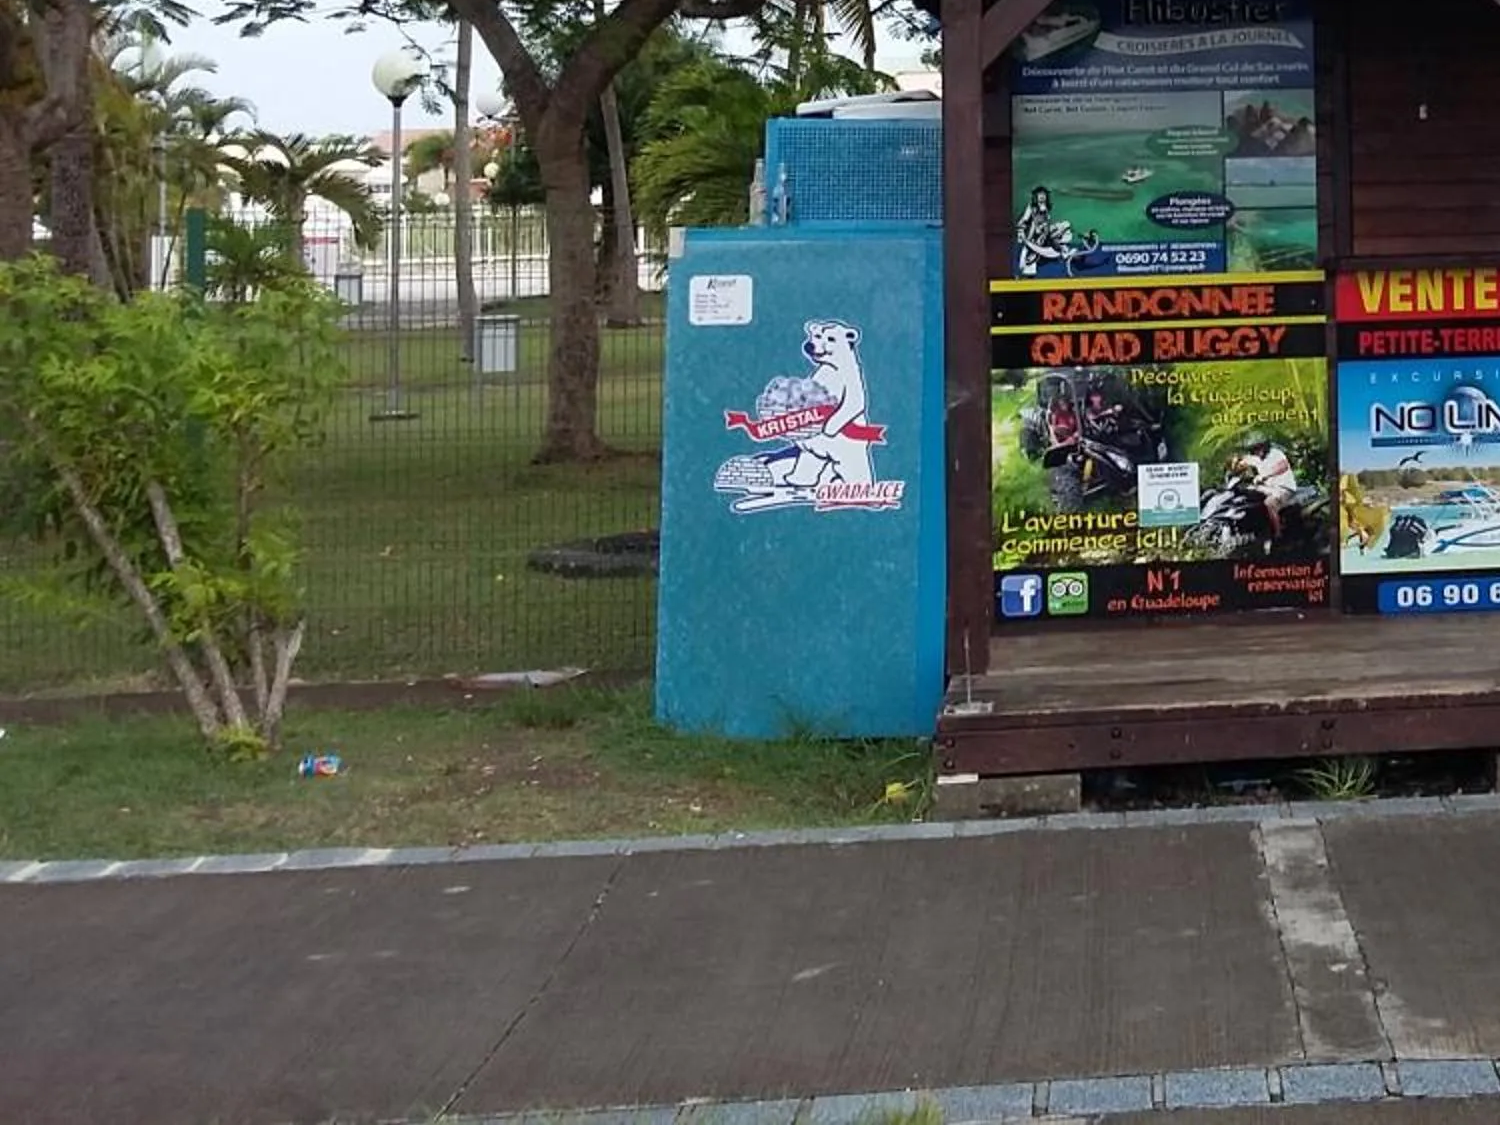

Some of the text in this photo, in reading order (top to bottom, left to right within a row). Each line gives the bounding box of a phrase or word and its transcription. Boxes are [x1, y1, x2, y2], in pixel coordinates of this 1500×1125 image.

[1115, 251, 1149, 264] 0690
[1151, 251, 1168, 263] 74
[1189, 250, 1206, 263] 23
[1357, 268, 1499, 313] VENTE
[1031, 326, 1287, 364] QUAD BUGGY
[1167, 387, 1184, 406] la
[757, 406, 825, 438] KRISTAL
[1211, 407, 1318, 425] autrement
[1371, 400, 1437, 434] NO
[1002, 511, 1137, 534] L'aventure
[1002, 534, 1127, 554] commence
[1107, 592, 1221, 612] en Guadeloupe
[1397, 586, 1433, 608] 06
[1443, 584, 1479, 605] 90
